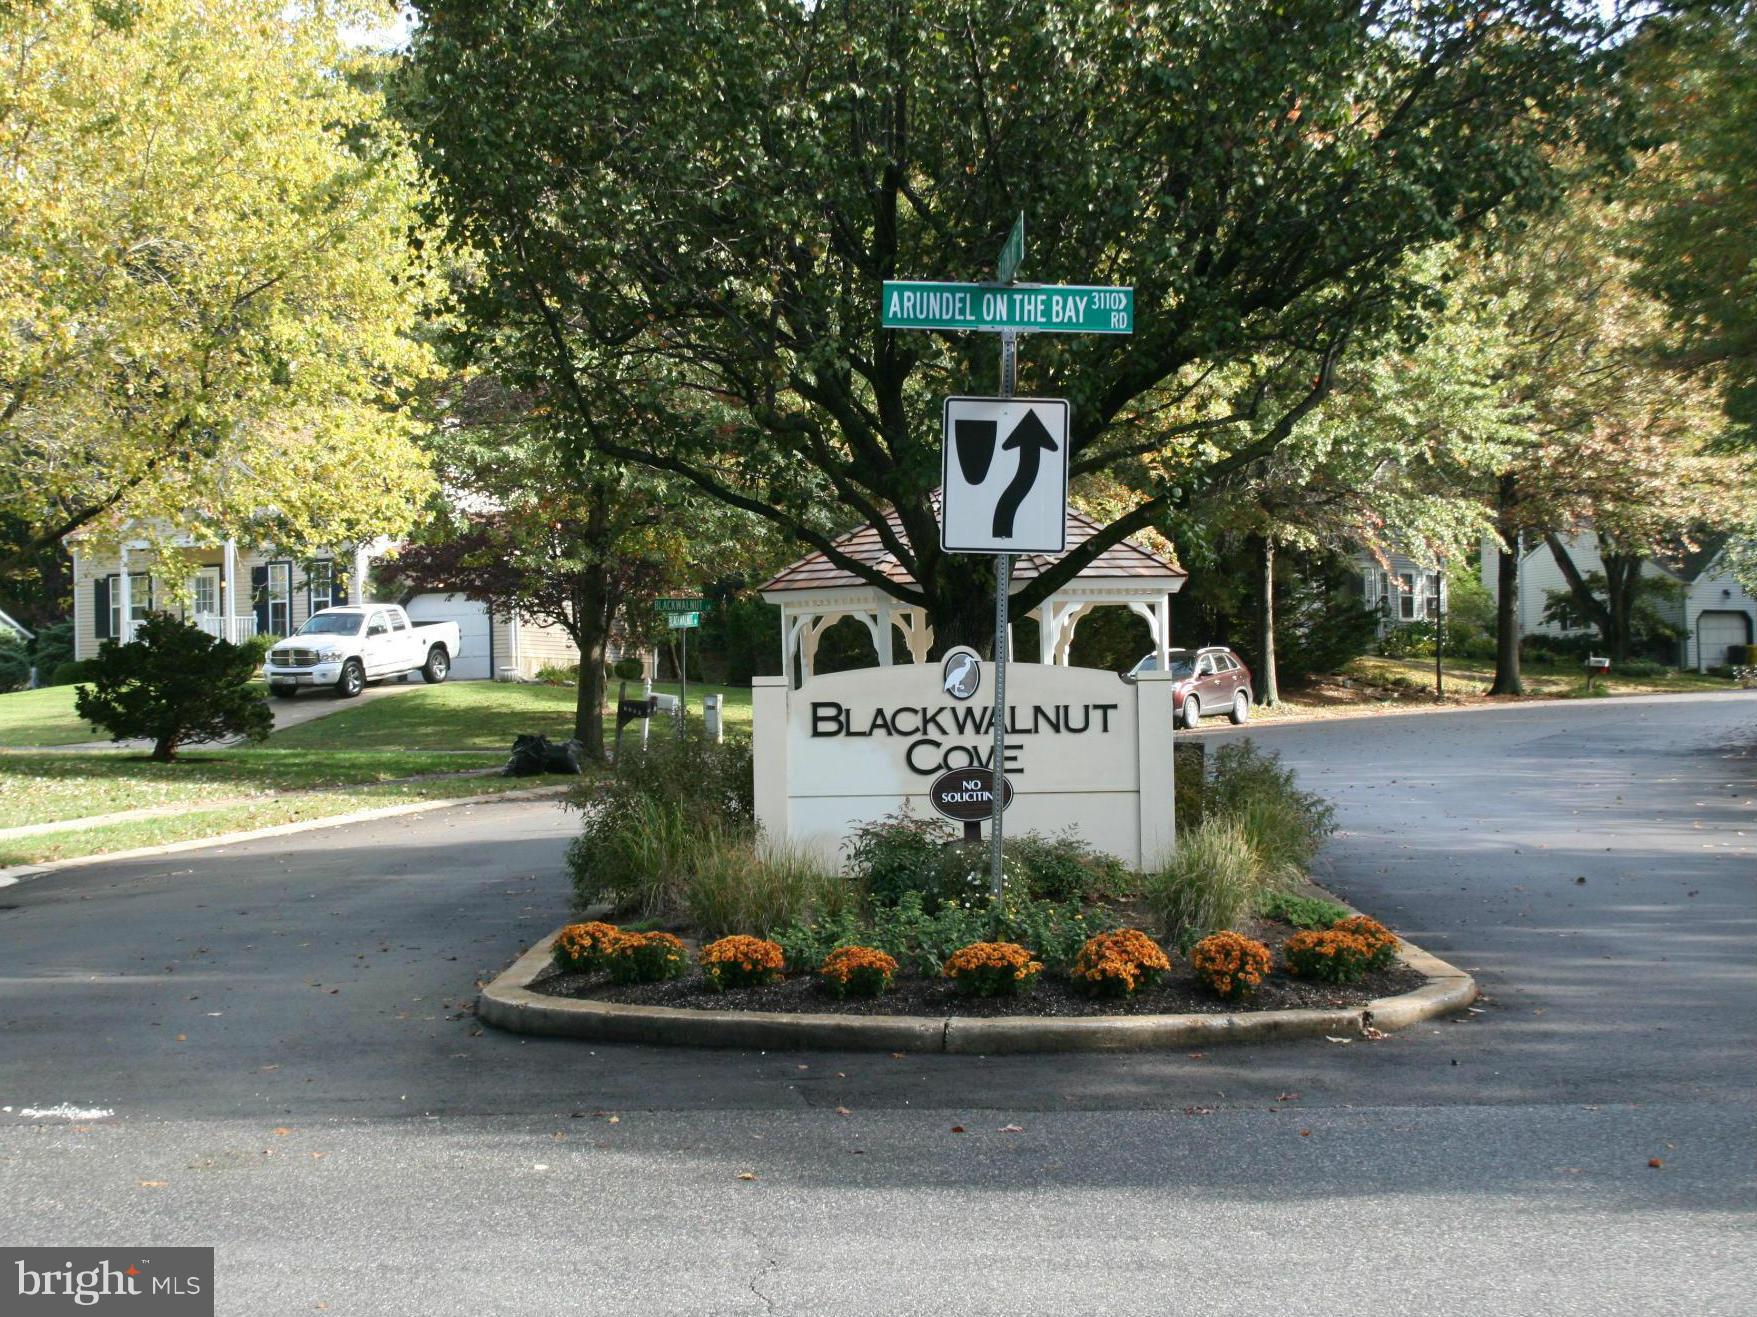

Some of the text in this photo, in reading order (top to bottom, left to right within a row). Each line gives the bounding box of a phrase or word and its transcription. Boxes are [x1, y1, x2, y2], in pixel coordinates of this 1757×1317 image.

[888, 291, 1089, 324] ARUNDEL ON THE BAY
[1091, 292, 1119, 310] 3110
[1110, 311, 1128, 329] RD
[962, 780, 982, 791] NO
[941, 791, 994, 803] SOLICITIN
